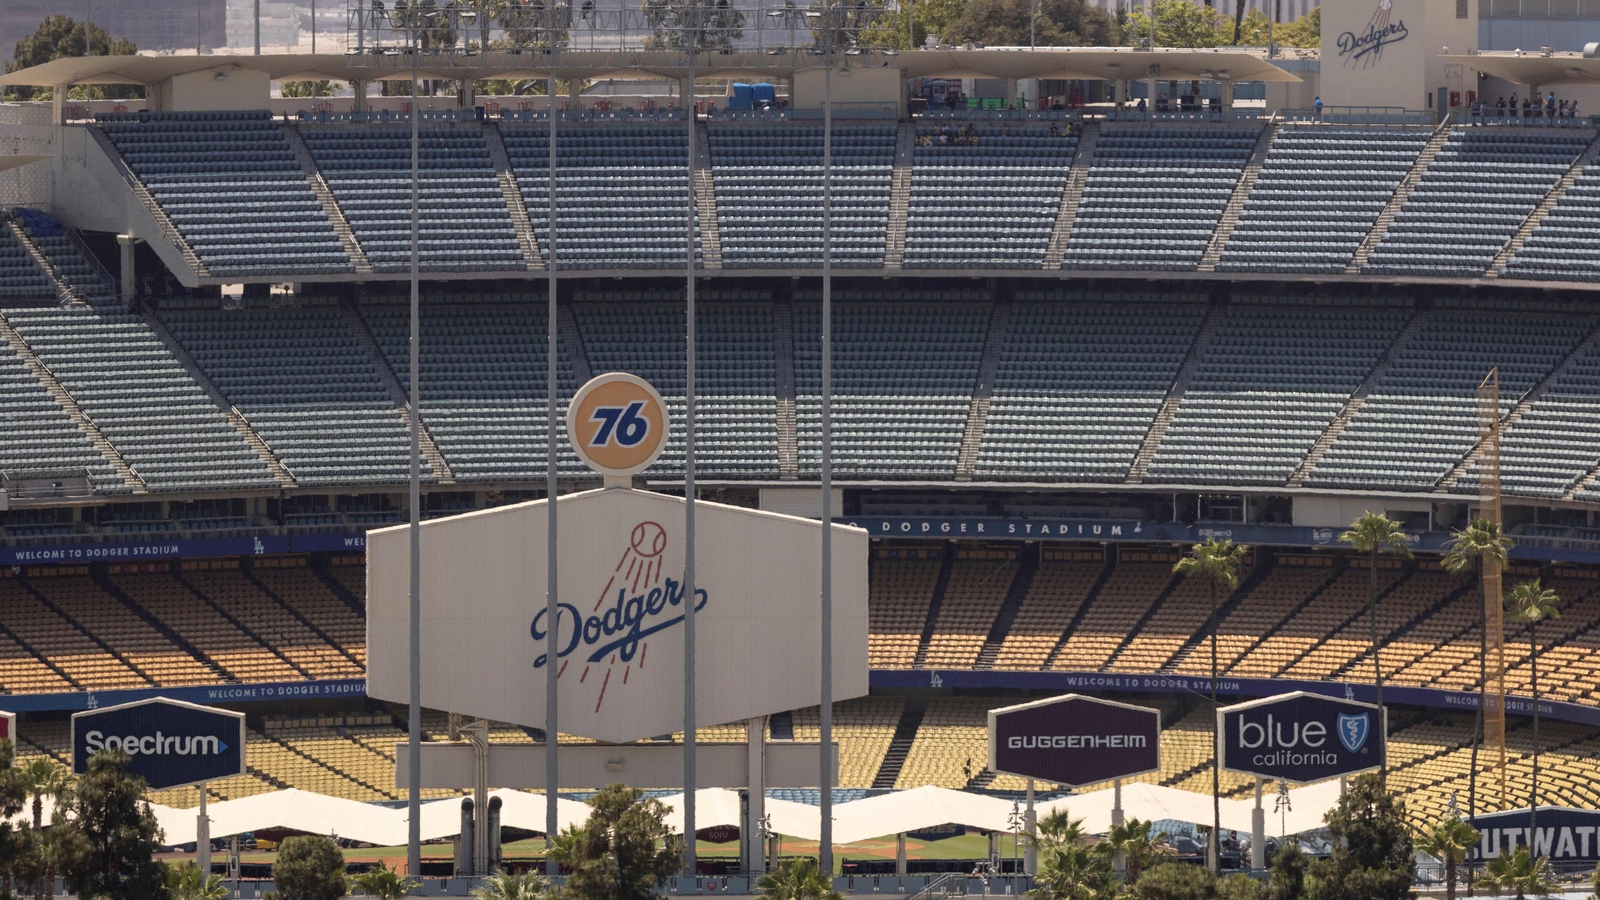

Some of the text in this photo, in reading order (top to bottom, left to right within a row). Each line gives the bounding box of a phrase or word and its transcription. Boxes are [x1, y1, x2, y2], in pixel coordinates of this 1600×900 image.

[1337, 20, 1408, 59] Dodgers
[587, 400, 650, 448] 76
[882, 521, 1122, 535] DODGER STADIUM
[15, 545, 179, 560] WELCOME TO DODGER STADIUM
[531, 572, 708, 668] Dodger
[1067, 677, 1120, 687] WELCOME
[1125, 678, 1138, 688] TO
[1144, 679, 1188, 689] DODGER
[208, 688, 256, 699] WELCOME
[261, 687, 273, 696] TO
[278, 685, 320, 696] DODGER
[1445, 695, 1479, 706] WELCOM
[1526, 702, 1553, 714] STDIUM
[1239, 714, 1327, 748] blue
[1008, 735, 1146, 749] GUGGENHEIM
[1253, 750, 1337, 767] california
[709, 831, 729, 839] SOJU
